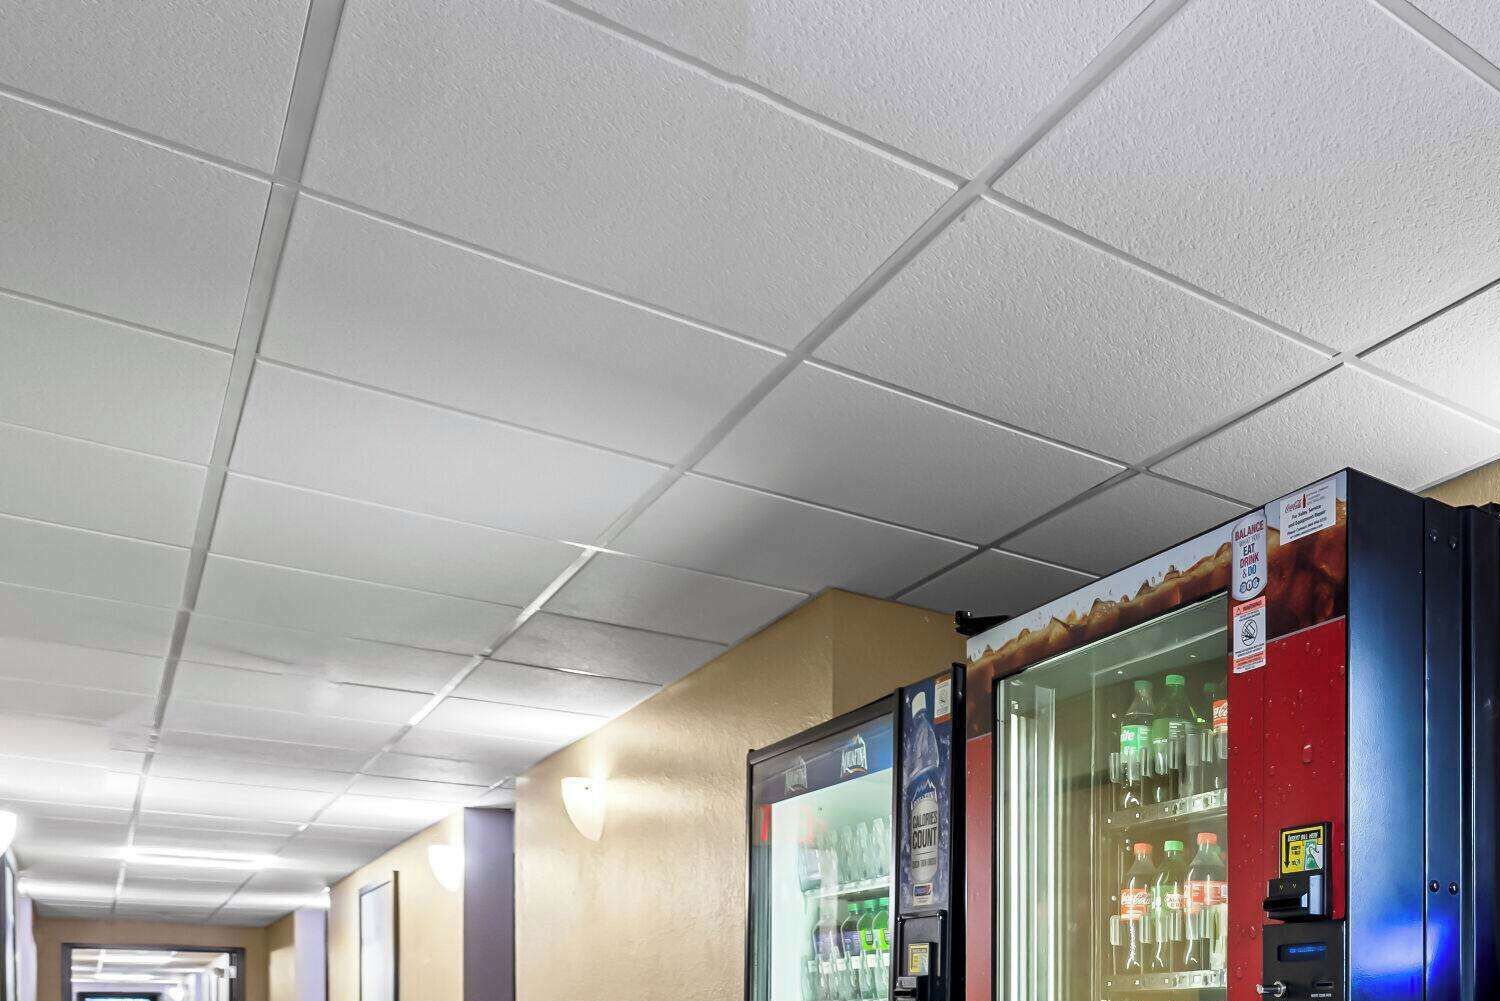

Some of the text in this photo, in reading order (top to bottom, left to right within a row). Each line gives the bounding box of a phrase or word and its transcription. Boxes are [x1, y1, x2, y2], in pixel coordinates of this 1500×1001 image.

[1235, 520, 1264, 541] BALANCE
[1243, 543, 1255, 556] EAT
[1240, 551, 1260, 568] DRINK
[913, 811, 938, 829] CALORIES
[912, 827, 937, 850] COUNT
